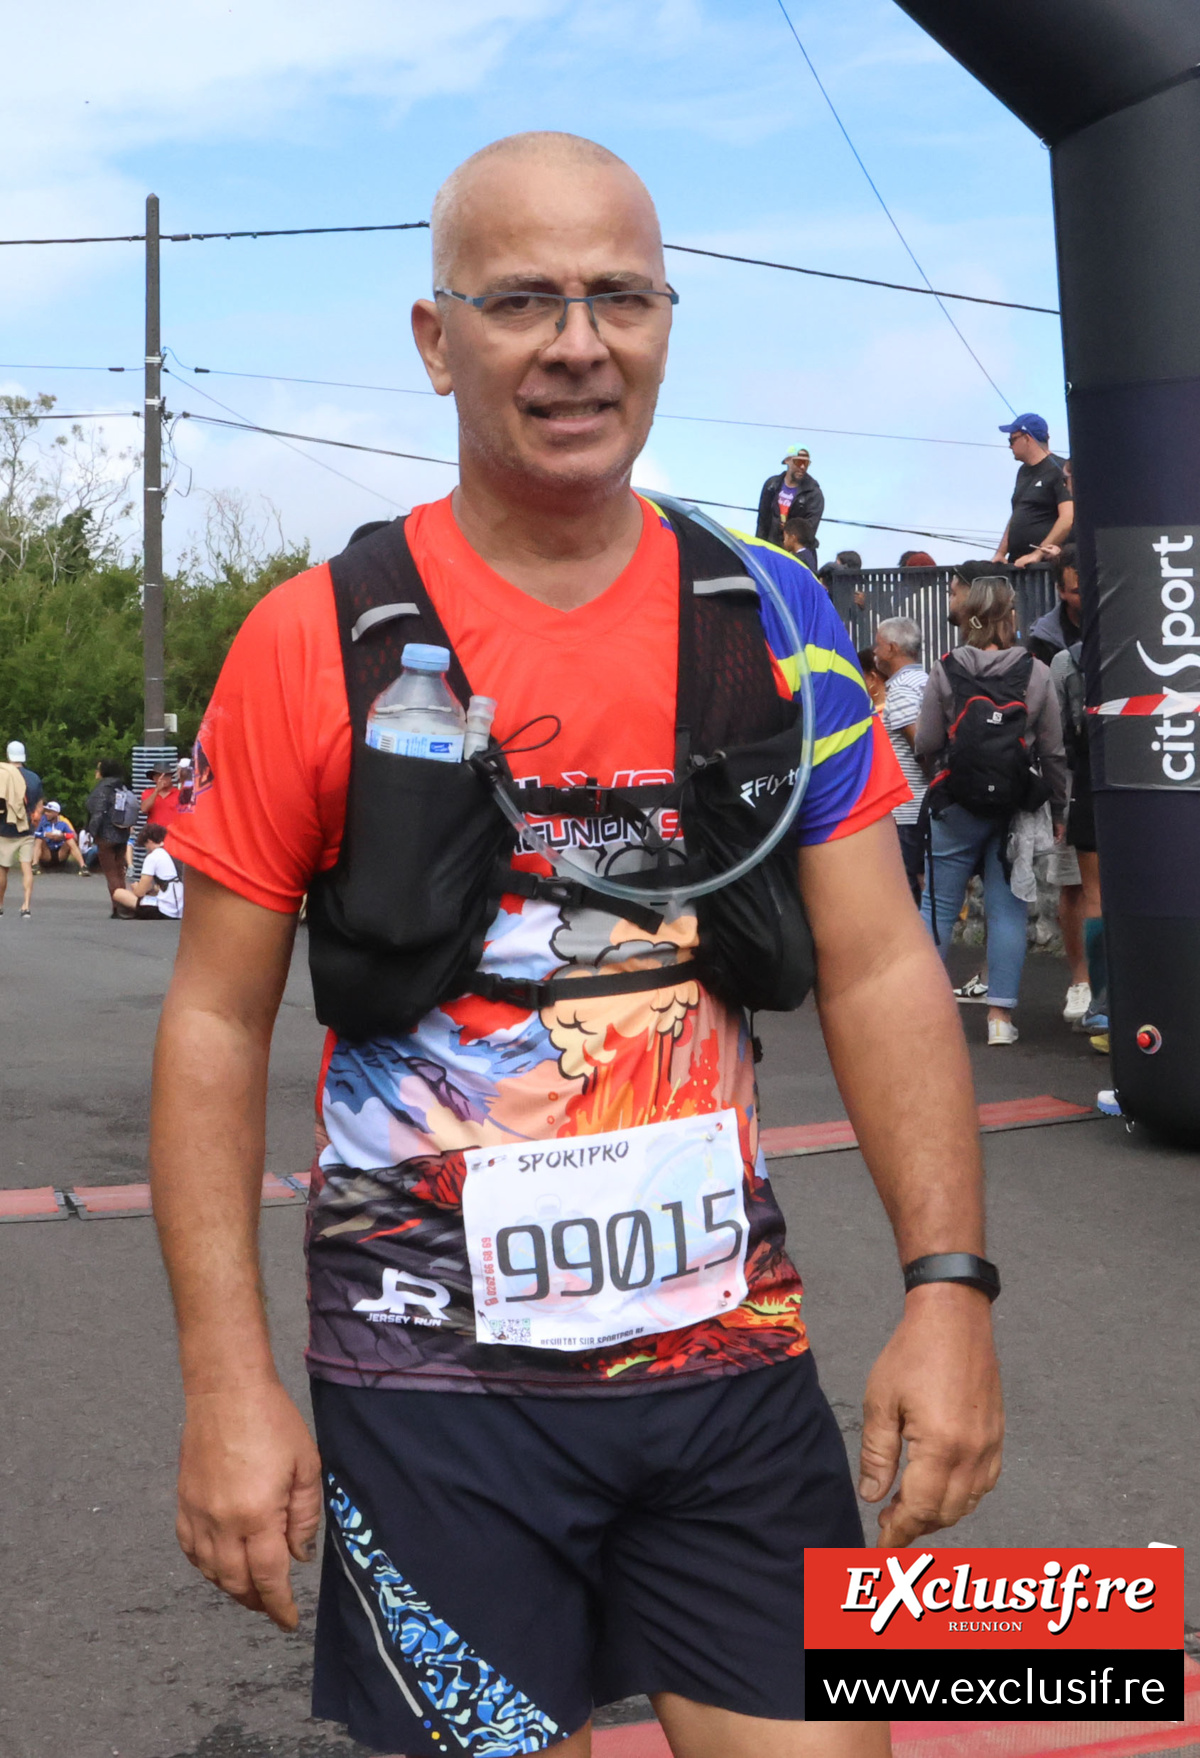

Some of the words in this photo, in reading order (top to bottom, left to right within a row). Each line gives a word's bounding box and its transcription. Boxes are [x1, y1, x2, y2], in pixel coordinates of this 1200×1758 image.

[518, 1141, 630, 1173] SPORTPRO
[496, 1189, 743, 1302] 99015
[366, 1312, 411, 1325] JERSEY
[413, 1315, 443, 1327] RUN
